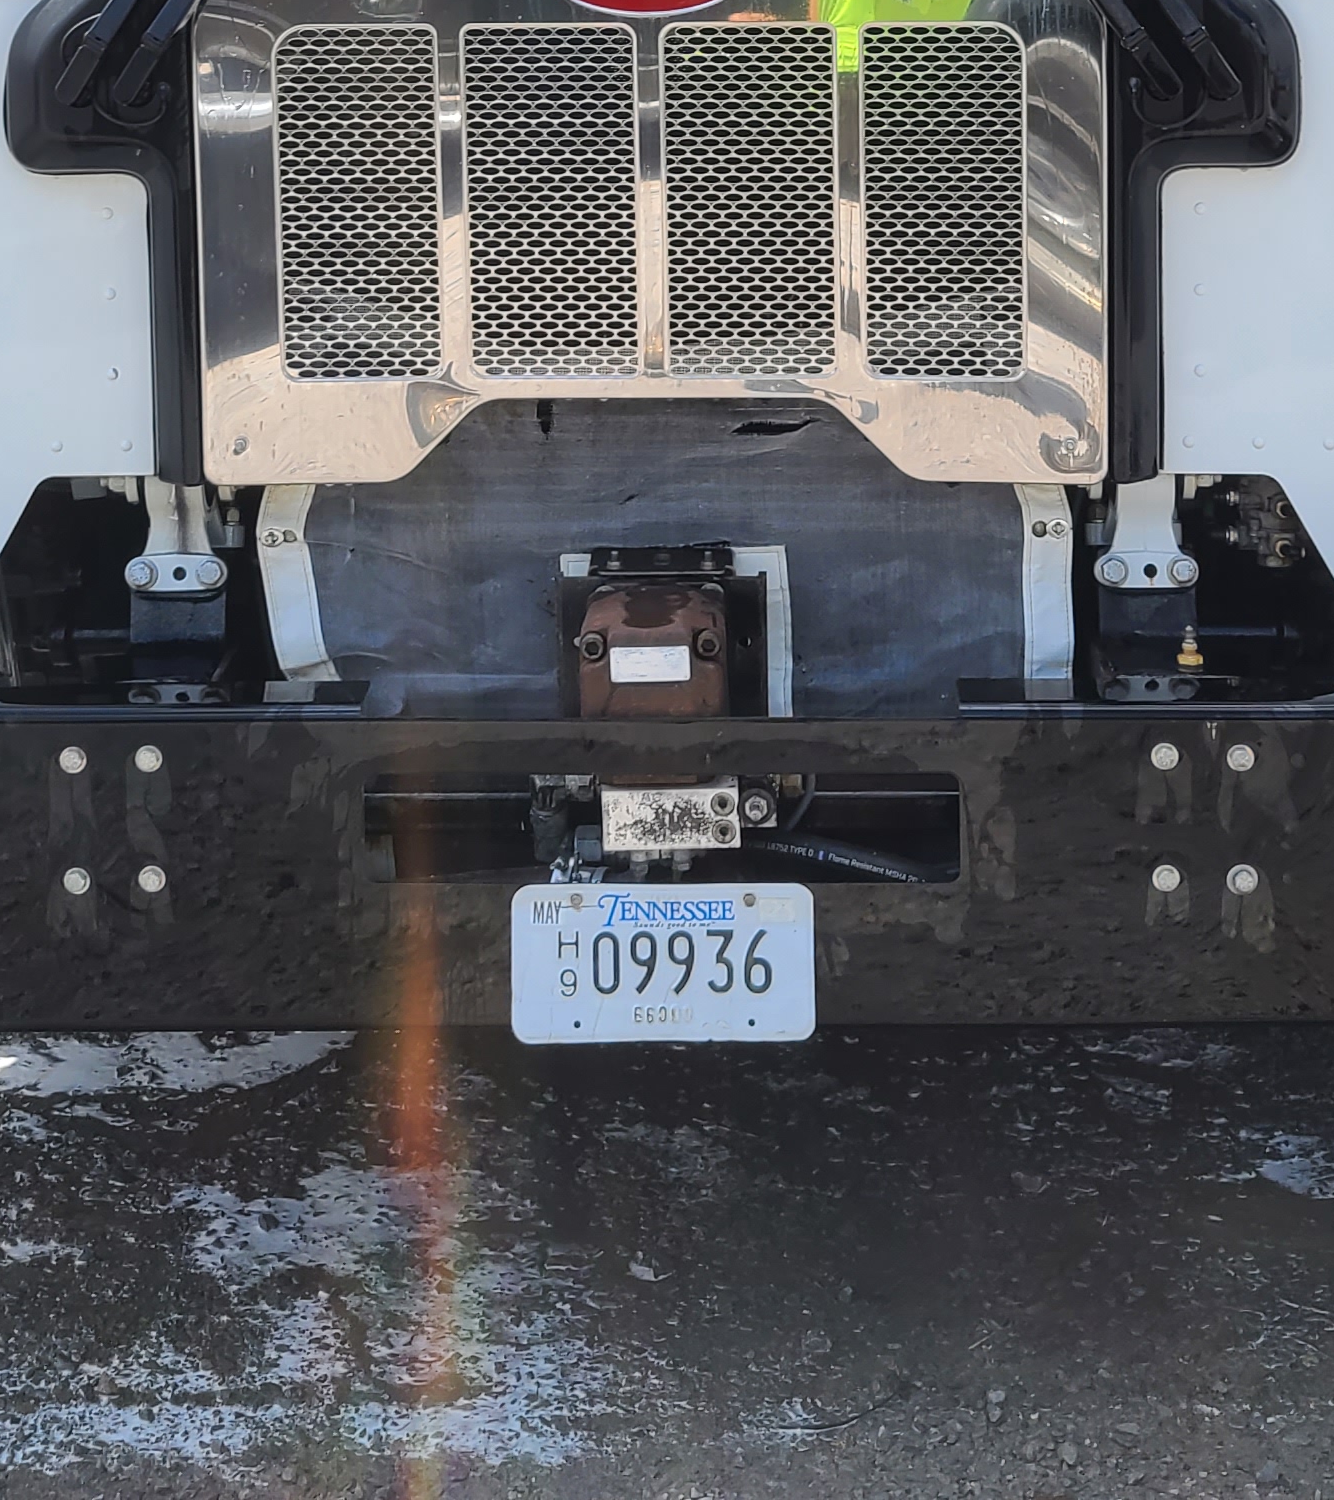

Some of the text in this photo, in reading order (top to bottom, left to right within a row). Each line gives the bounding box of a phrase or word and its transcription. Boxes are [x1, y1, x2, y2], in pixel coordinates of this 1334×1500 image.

[790, 844, 807, 856] TYPE
[851, 858, 885, 874] Resistant
[885, 868, 907, 881] MSHA
[533, 893, 735, 927] MAY TENNESSEE
[592, 929, 773, 995] 09936
